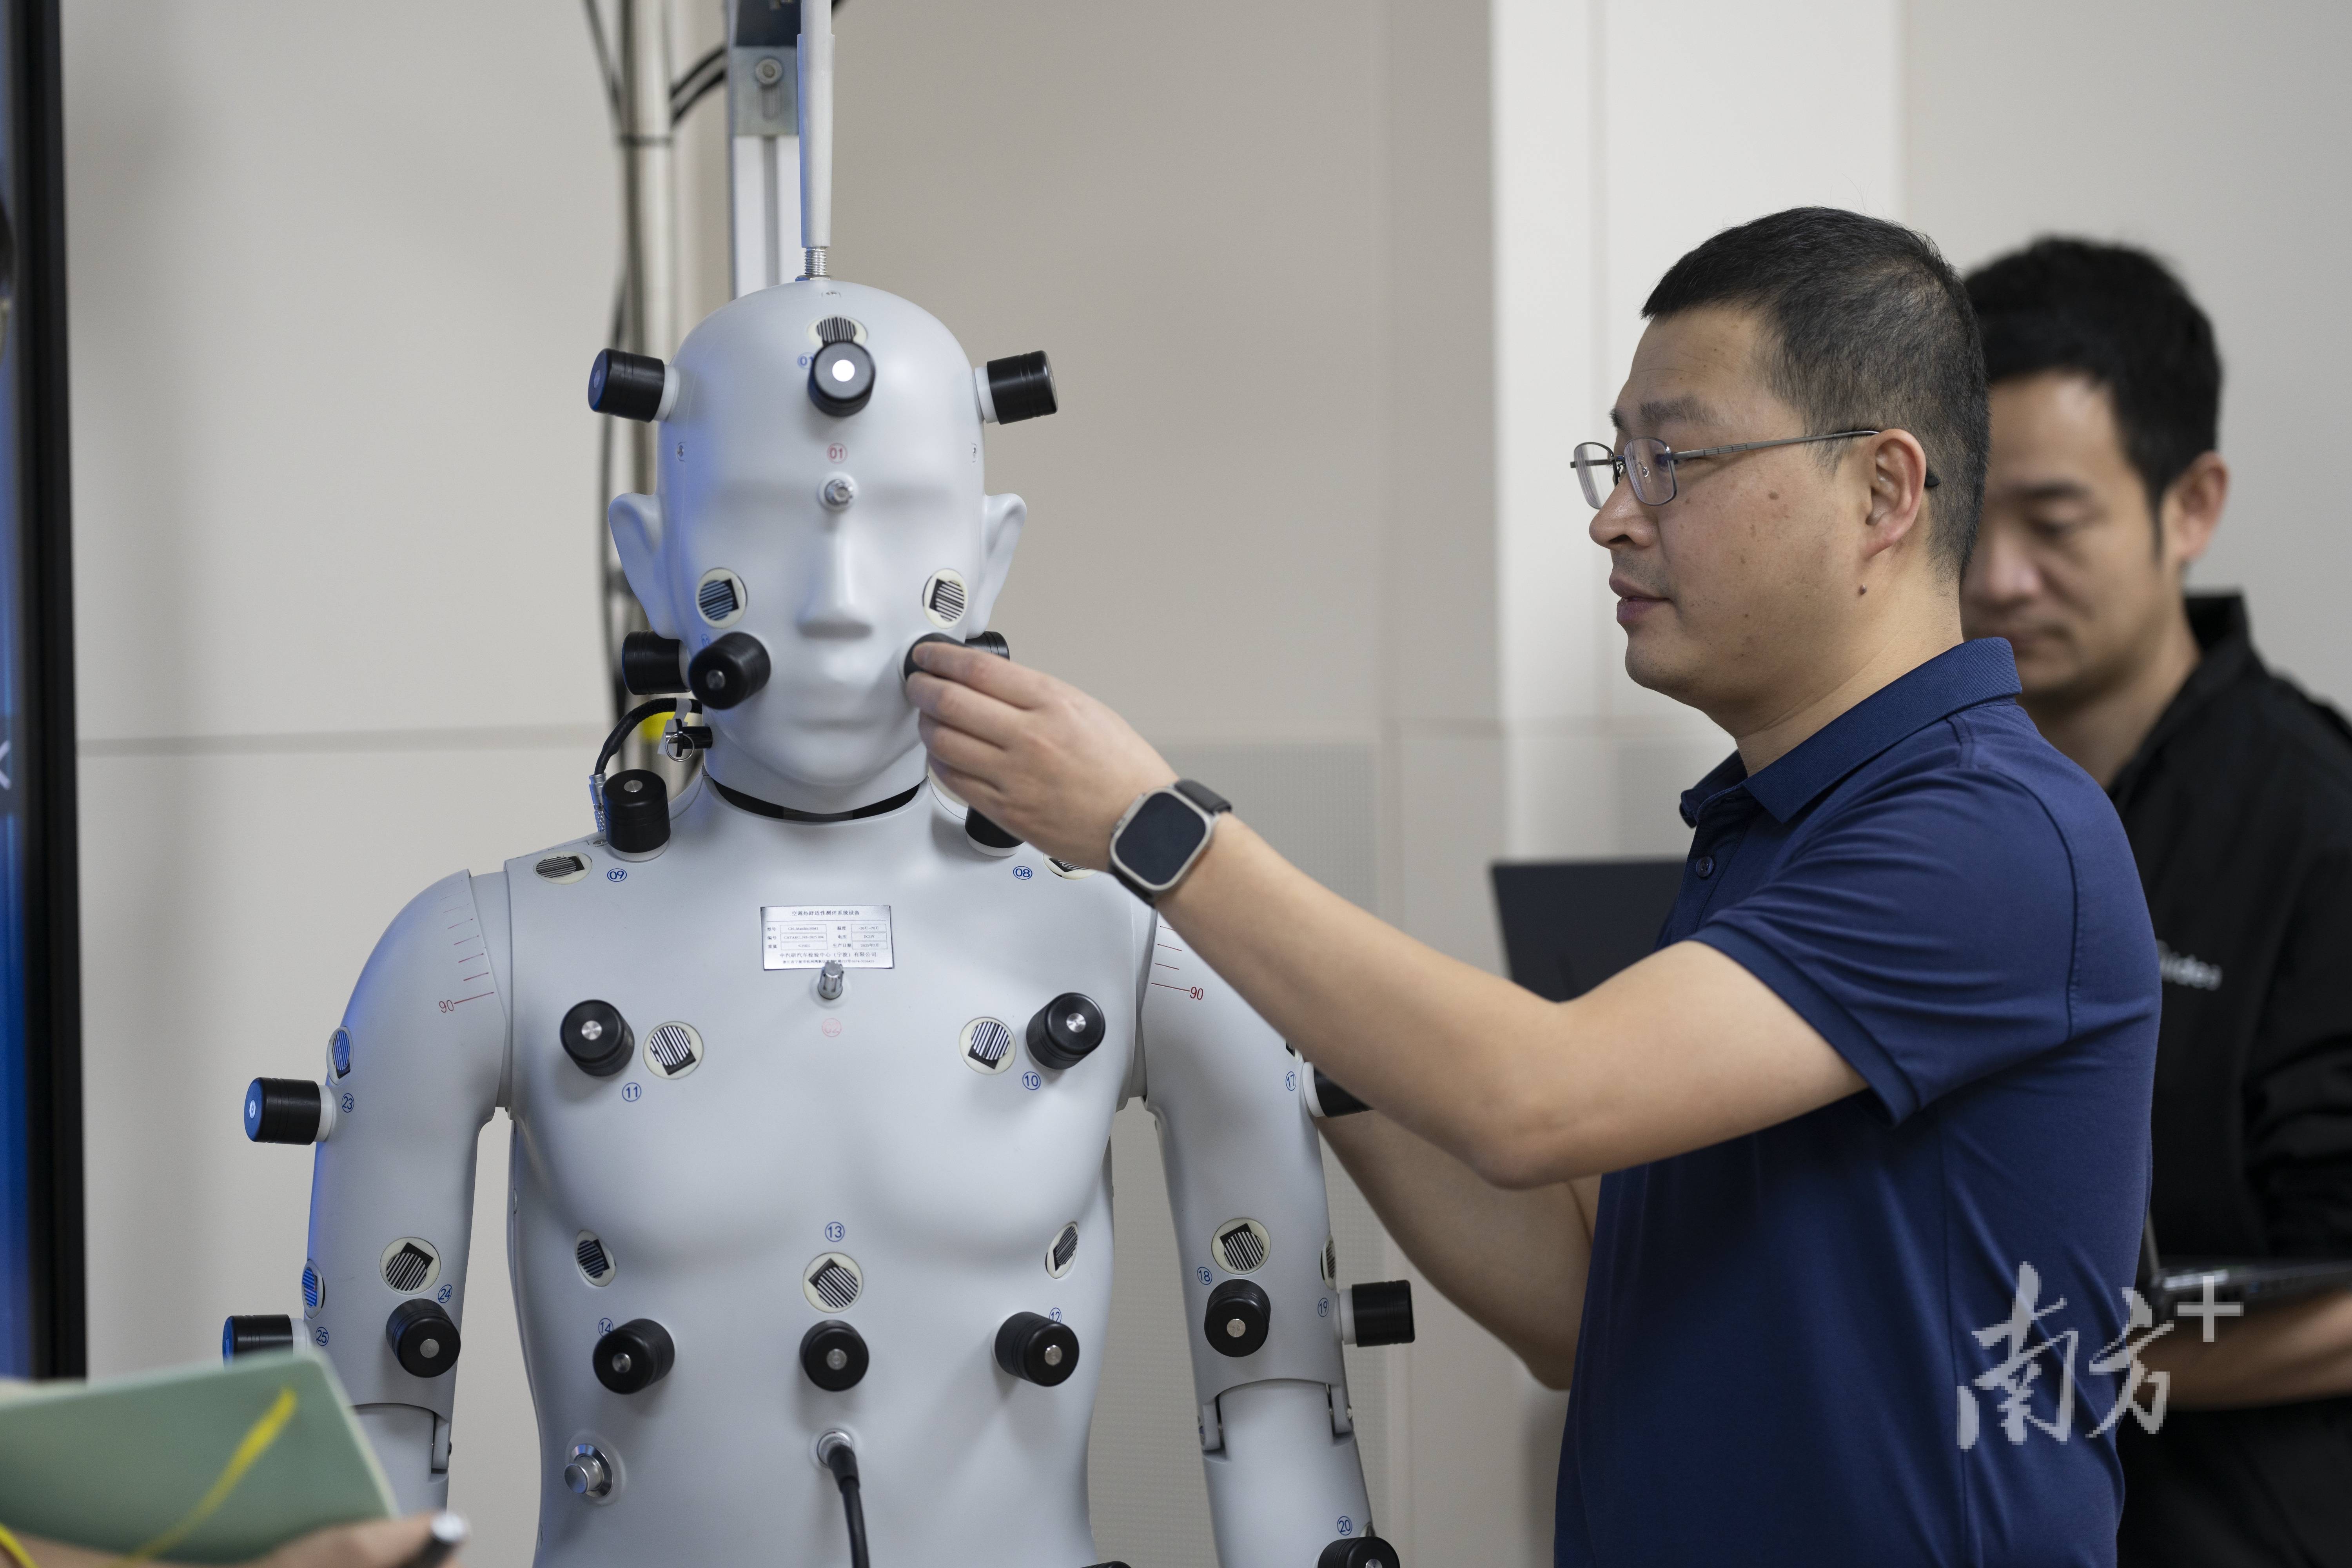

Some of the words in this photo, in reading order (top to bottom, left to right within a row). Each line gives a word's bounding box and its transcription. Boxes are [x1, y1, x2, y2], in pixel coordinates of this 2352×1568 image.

[829, 446, 844, 460] 01
[608, 869, 625, 880] 09
[1014, 867, 1031, 878] 08
[1190, 986, 1203, 1000] 90
[439, 1000, 454, 1013] 90
[823, 1021, 840, 1034] 02
[1024, 1074, 1039, 1088] 10
[1286, 1073, 1295, 1089] 17
[625, 1085, 639, 1099] 11
[341, 1095, 354, 1111] 23
[827, 1225, 843, 1239] 13
[1198, 1269, 1211, 1283] 18
[438, 1287, 452, 1301] 24
[1318, 1300, 1328, 1315] 19
[599, 1320, 613, 1334] 14
[316, 1329, 329, 1344] 25
[1338, 1519, 1352, 1534] 20
